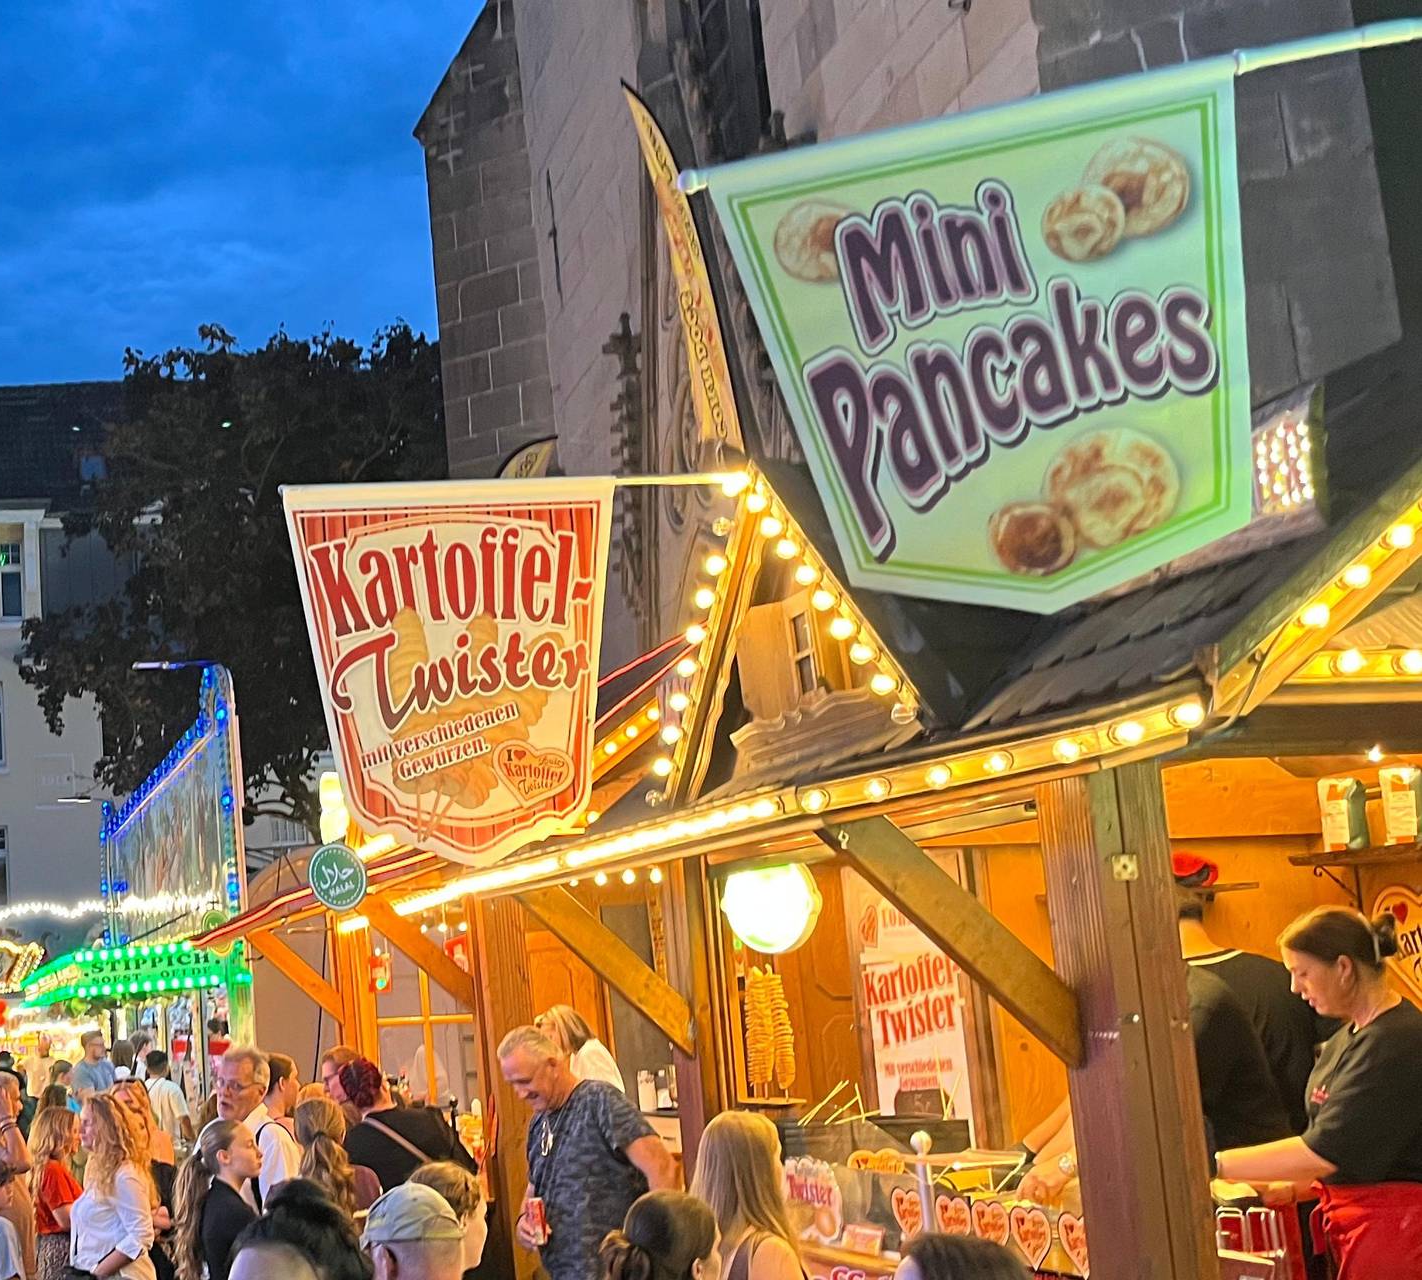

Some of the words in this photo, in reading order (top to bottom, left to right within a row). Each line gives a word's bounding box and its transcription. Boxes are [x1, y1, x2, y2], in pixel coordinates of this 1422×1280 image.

[835, 179, 1037, 354] Mini
[804, 276, 1218, 561] Pancakes
[309, 526, 595, 638] Kartoffel-
[330, 631, 589, 732] Twister
[362, 744, 390, 769] mit
[392, 703, 517, 756] verschiedenen
[399, 738, 489, 779] Gewürzen.
[503, 763, 563, 783] Kartoffel
[877, 994, 957, 1047] Twister
